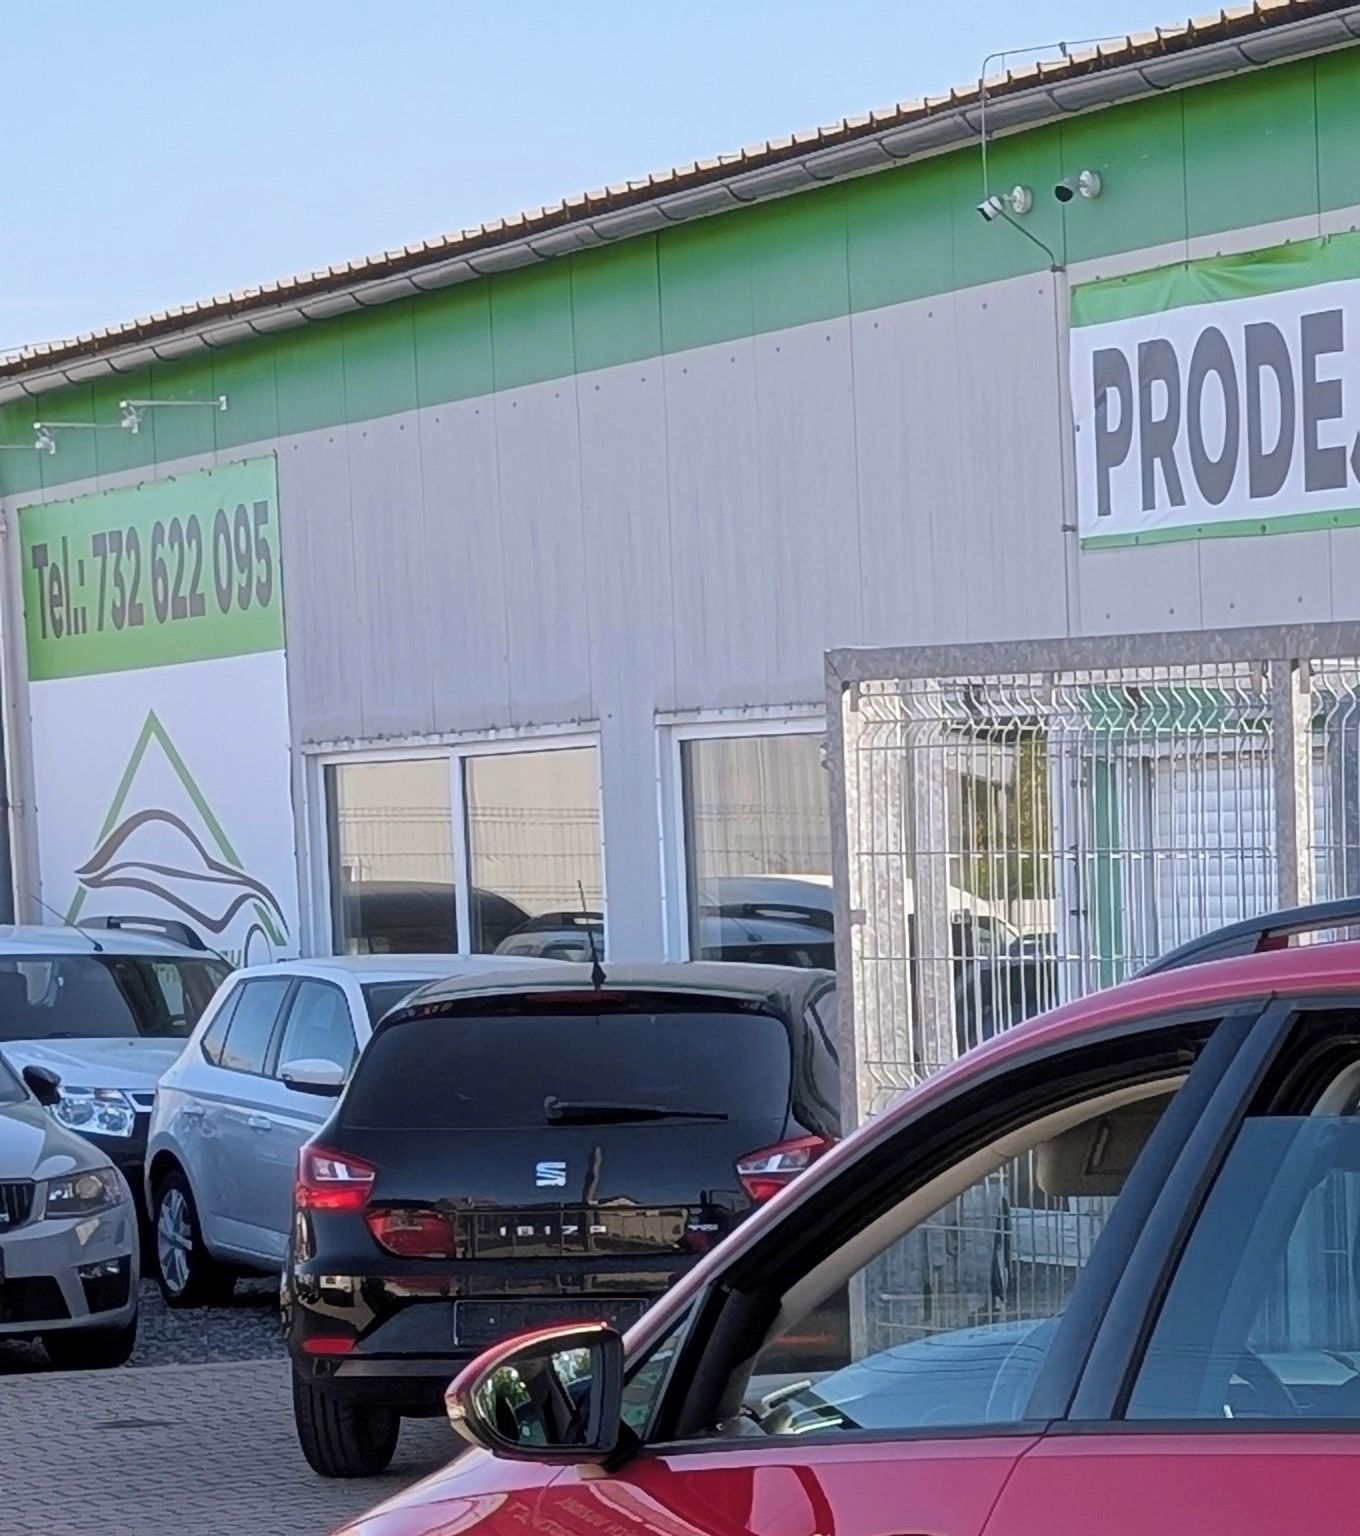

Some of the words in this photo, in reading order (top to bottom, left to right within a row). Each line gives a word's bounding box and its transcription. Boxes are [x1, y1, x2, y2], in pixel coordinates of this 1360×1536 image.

[31, 535, 88, 641] Tel.:
[92, 525, 145, 633] 732
[150, 513, 206, 625] 622
[212, 500, 273, 615] 095
